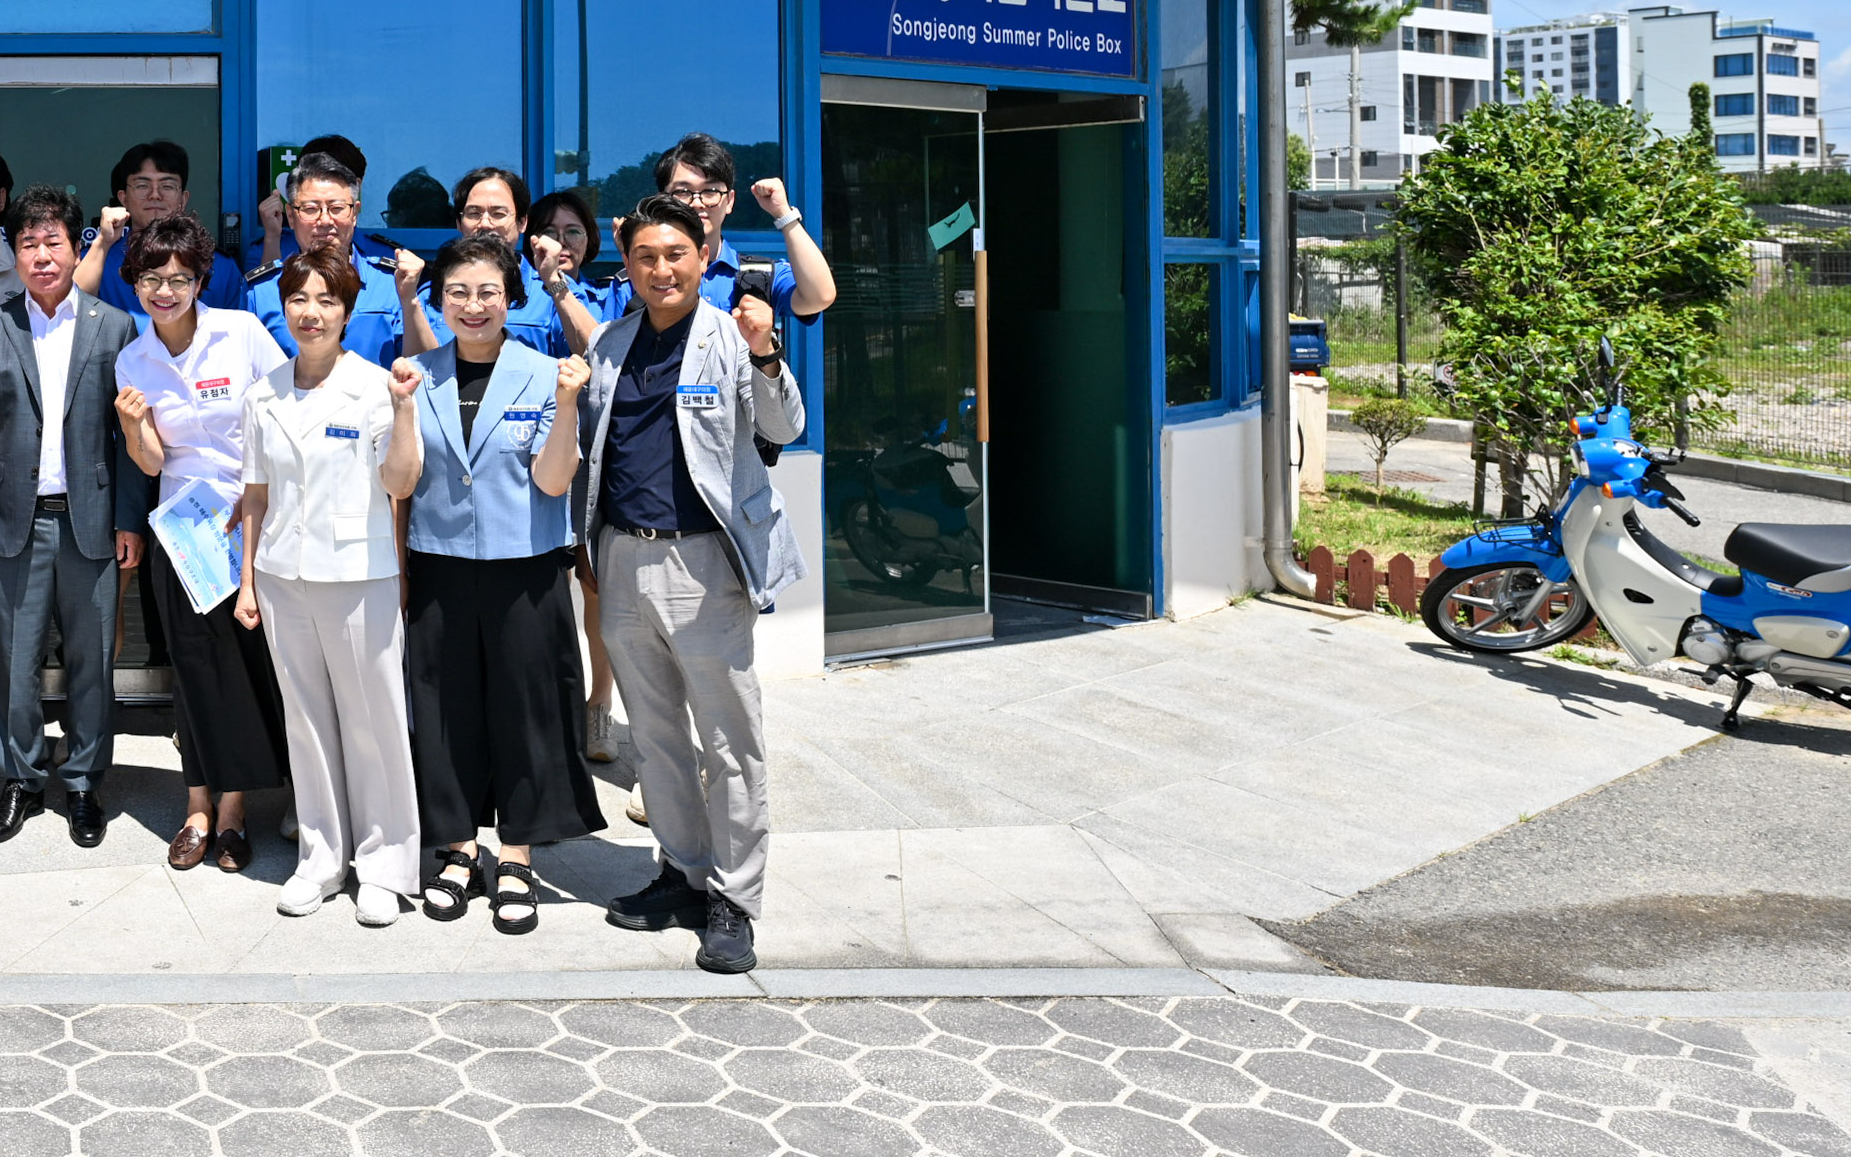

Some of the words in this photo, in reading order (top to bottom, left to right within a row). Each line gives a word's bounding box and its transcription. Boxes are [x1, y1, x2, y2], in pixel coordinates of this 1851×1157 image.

[892, 13, 976, 45] Songjeong
[983, 22, 1041, 47] Summer
[1048, 28, 1091, 52] Police
[1097, 33, 1122, 54] Box
